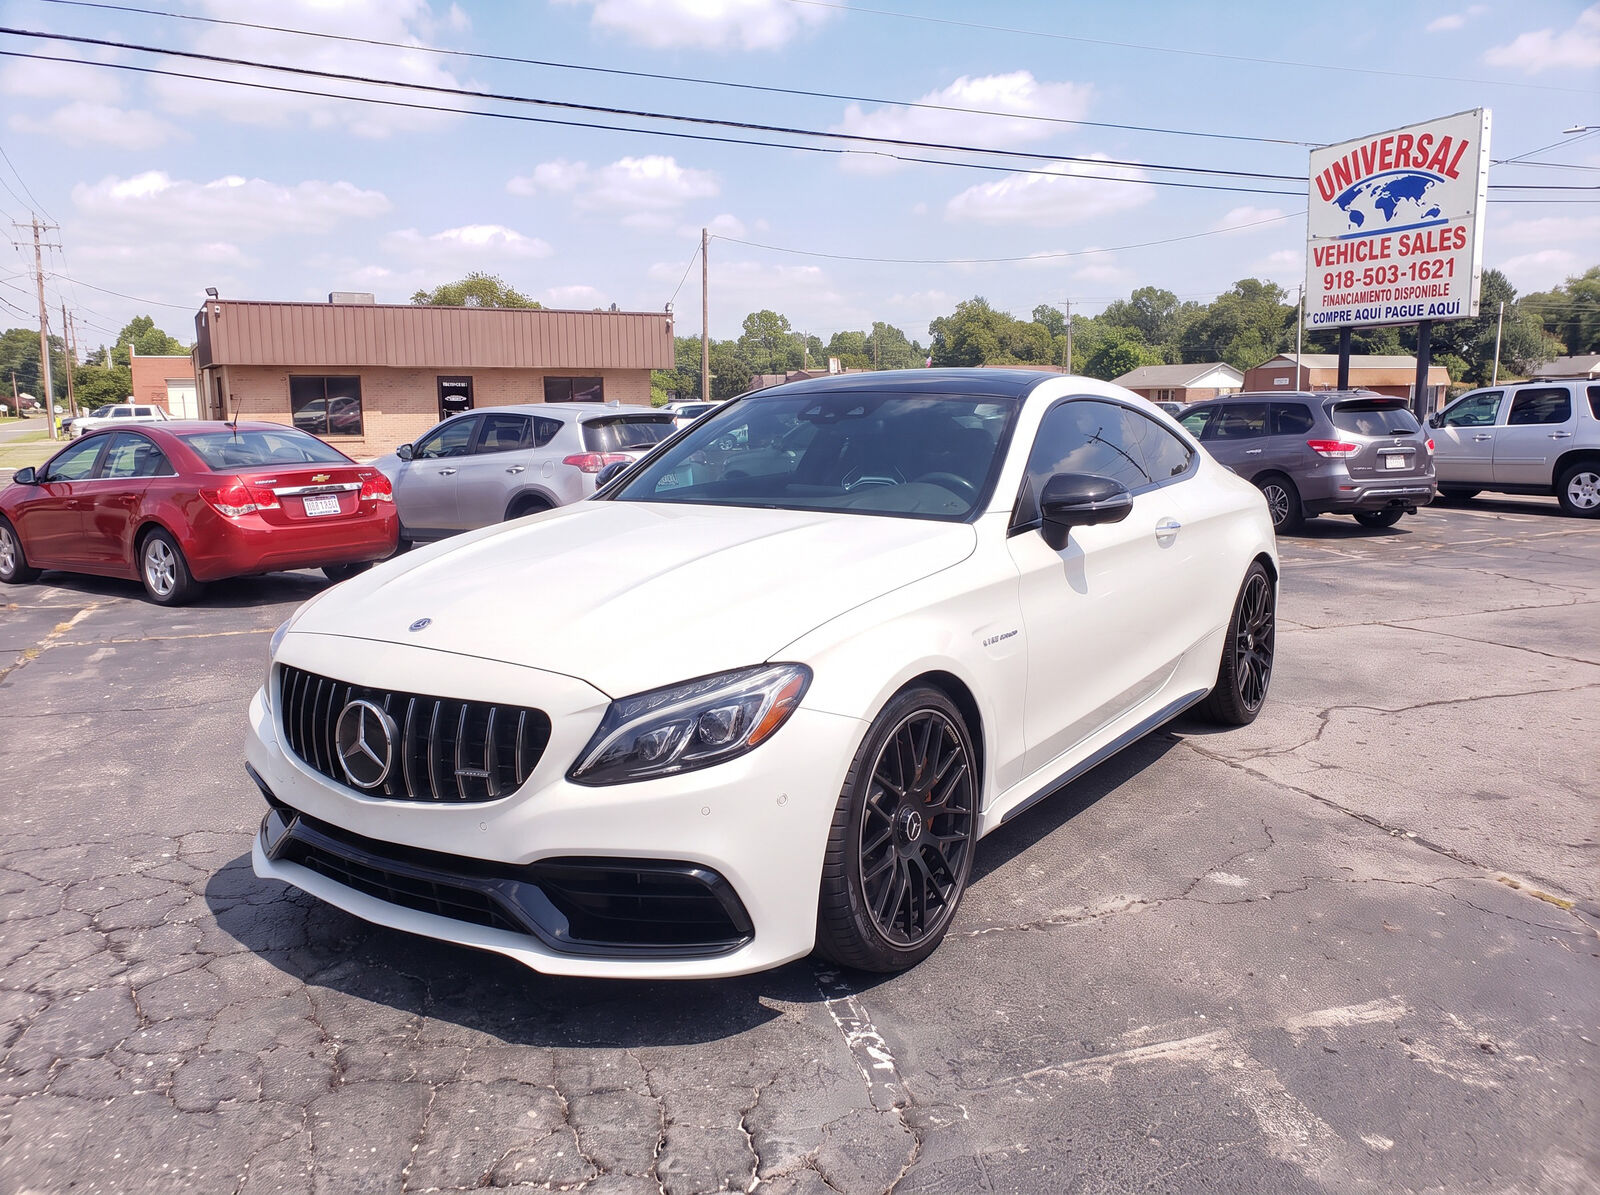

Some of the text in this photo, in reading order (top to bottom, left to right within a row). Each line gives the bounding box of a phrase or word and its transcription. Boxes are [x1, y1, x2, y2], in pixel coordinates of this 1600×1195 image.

[1315, 133, 1469, 201] UNIVERSAL
[1313, 225, 1466, 267] VEHICLE SALES
[1323, 257, 1455, 290] 918-503-1621
[1322, 283, 1450, 307] FINANCIAMIENTO DISPONIBLE
[1313, 309, 1352, 324] COMPRE
[1385, 304, 1424, 319] PAGUE
